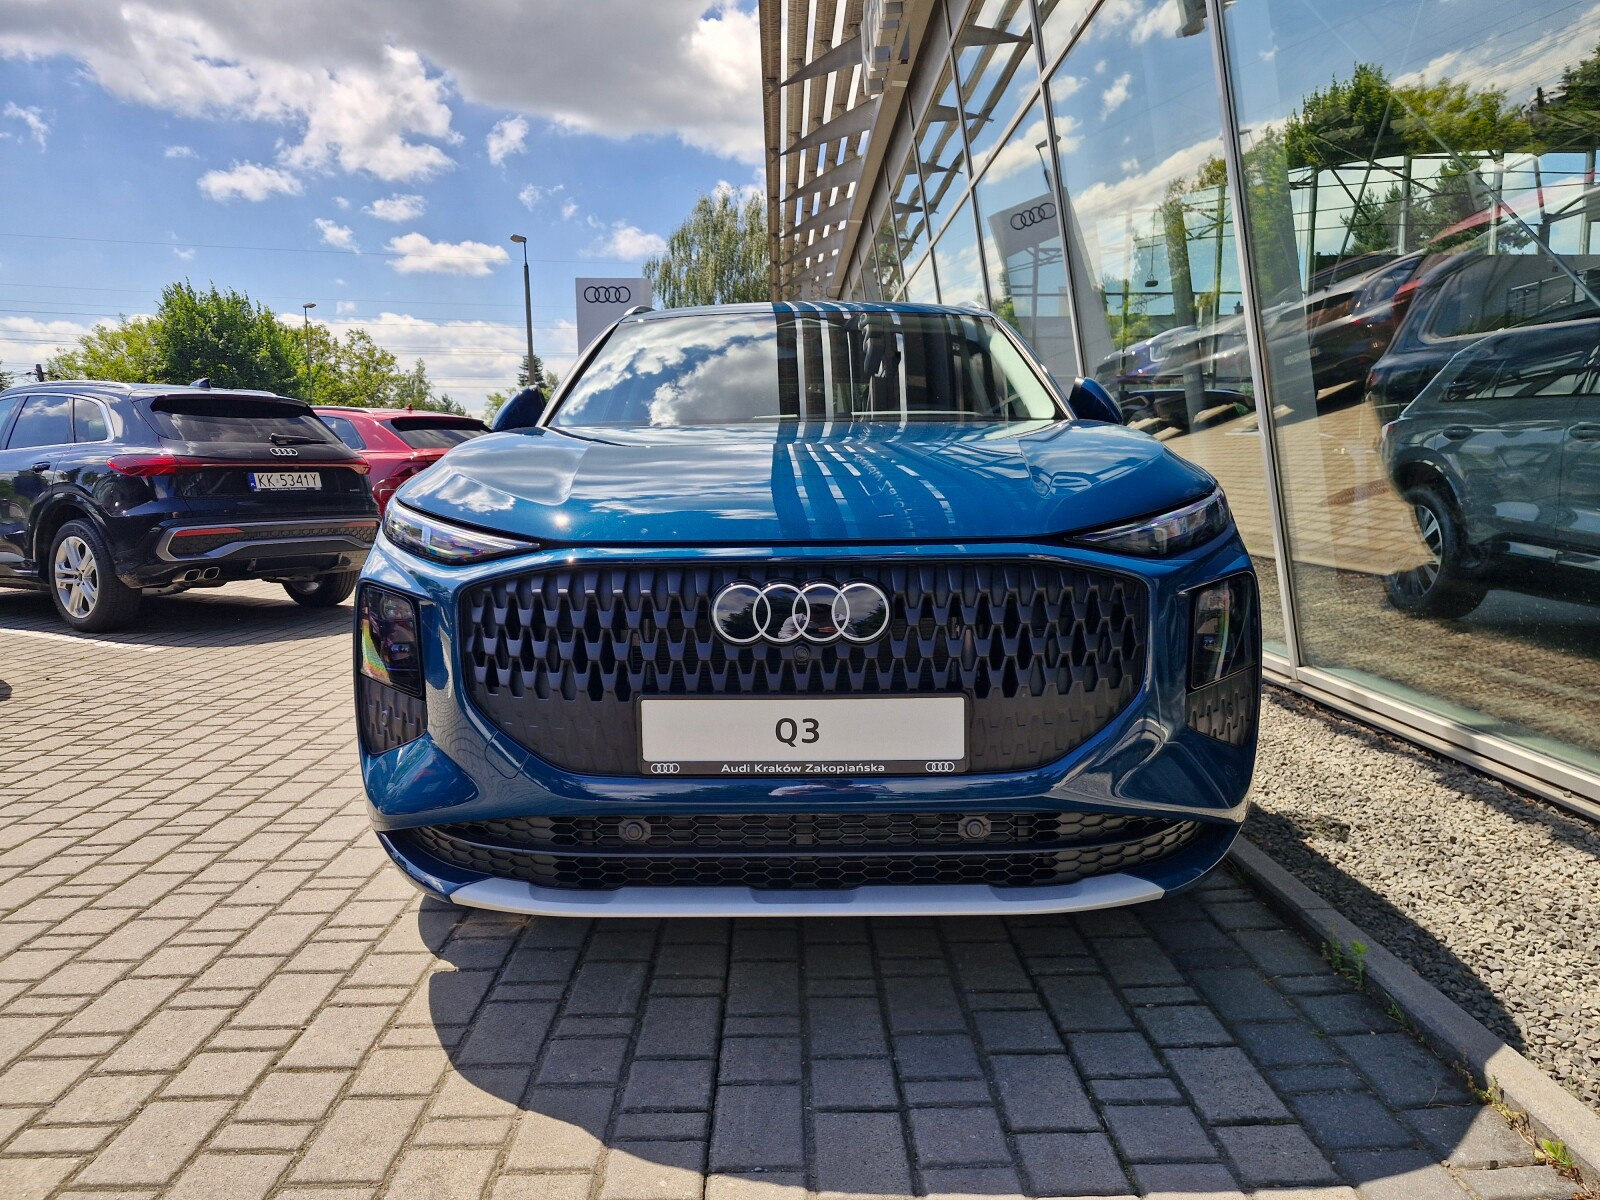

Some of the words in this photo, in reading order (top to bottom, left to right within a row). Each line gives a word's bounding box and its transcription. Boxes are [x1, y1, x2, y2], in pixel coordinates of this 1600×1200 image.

[257, 473, 276, 487] KK
[279, 473, 317, 487] 5341Y
[775, 717, 820, 748] Q3
[720, 763, 751, 773] Audi
[754, 762, 802, 773] Kraków
[805, 762, 886, 775] Zakopiańska
